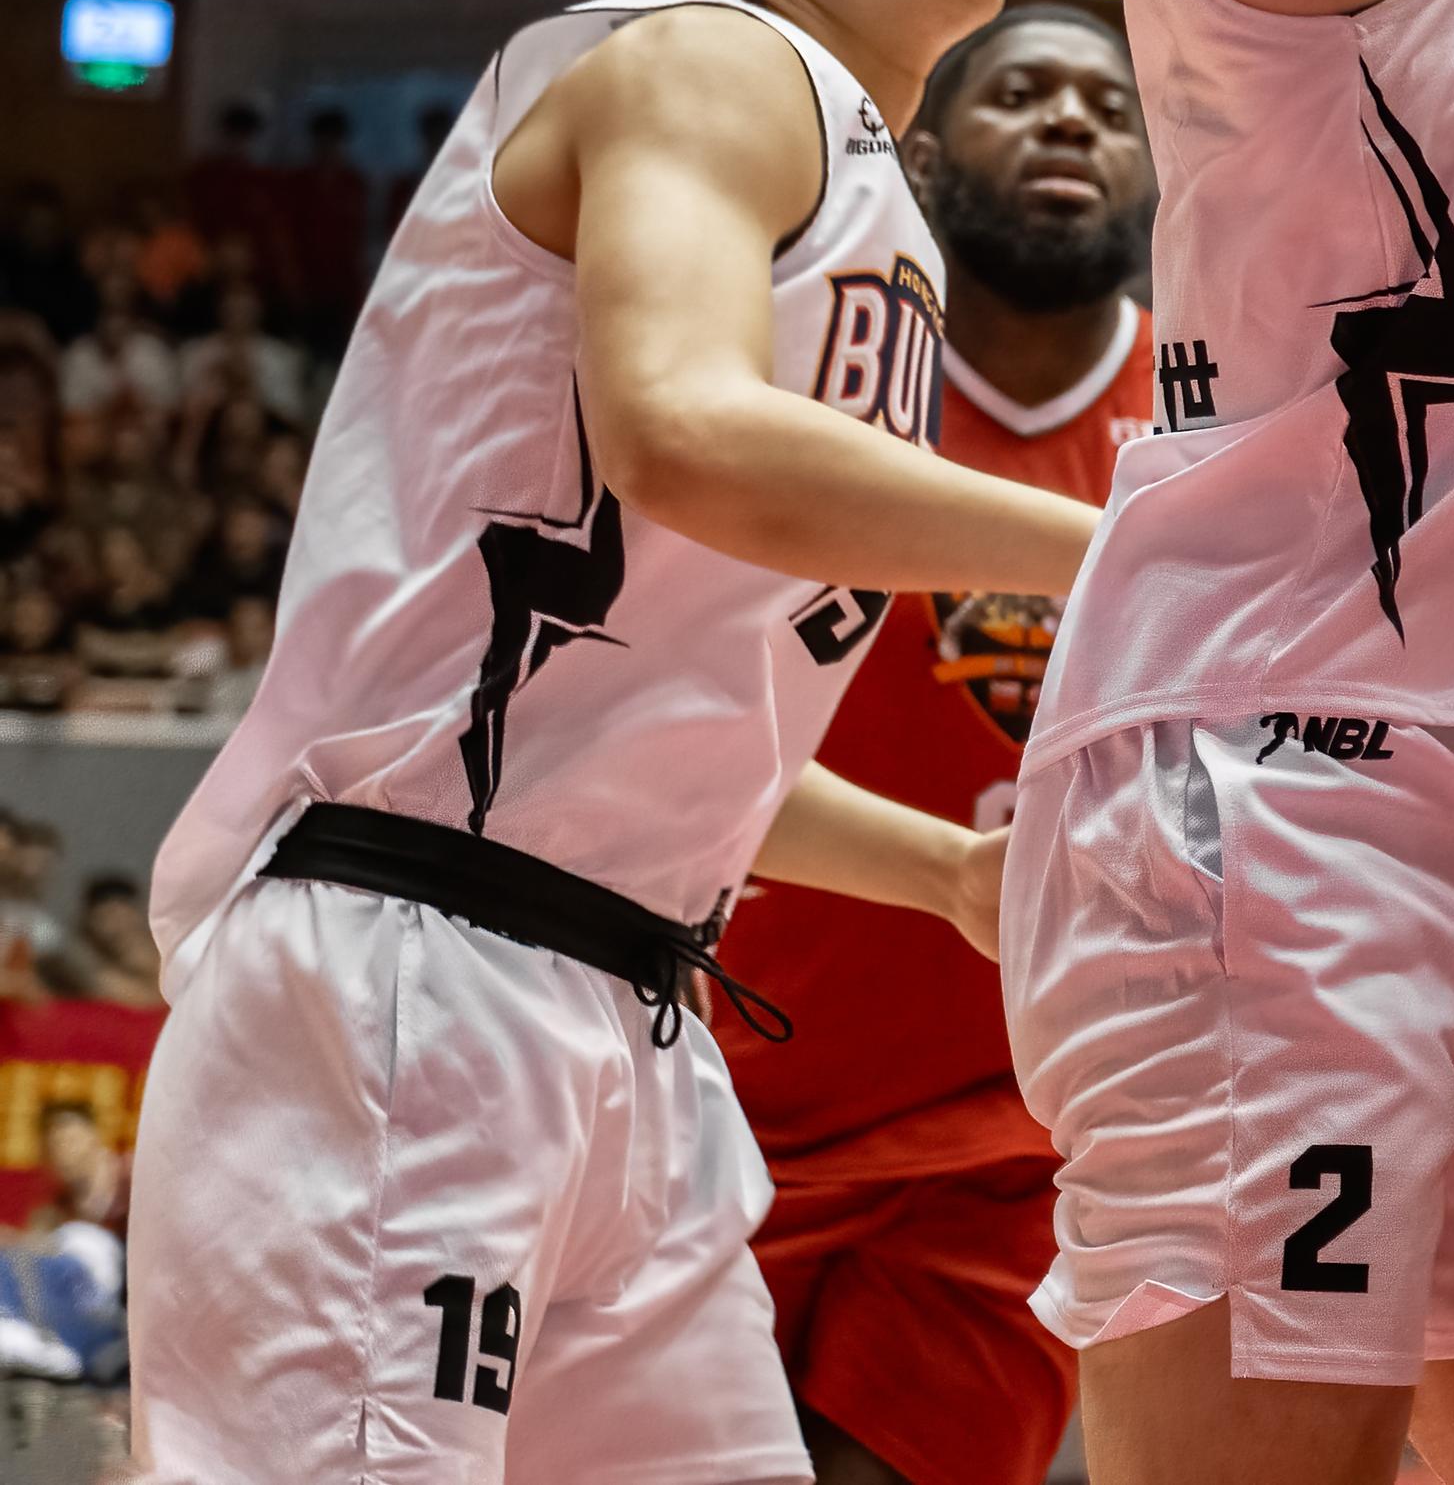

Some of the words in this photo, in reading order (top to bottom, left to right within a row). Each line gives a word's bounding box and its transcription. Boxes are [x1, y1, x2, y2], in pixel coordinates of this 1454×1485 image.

[1303, 716, 1395, 761] NBL
[1281, 1144, 1373, 1294] 2
[423, 1273, 522, 1416] 19
